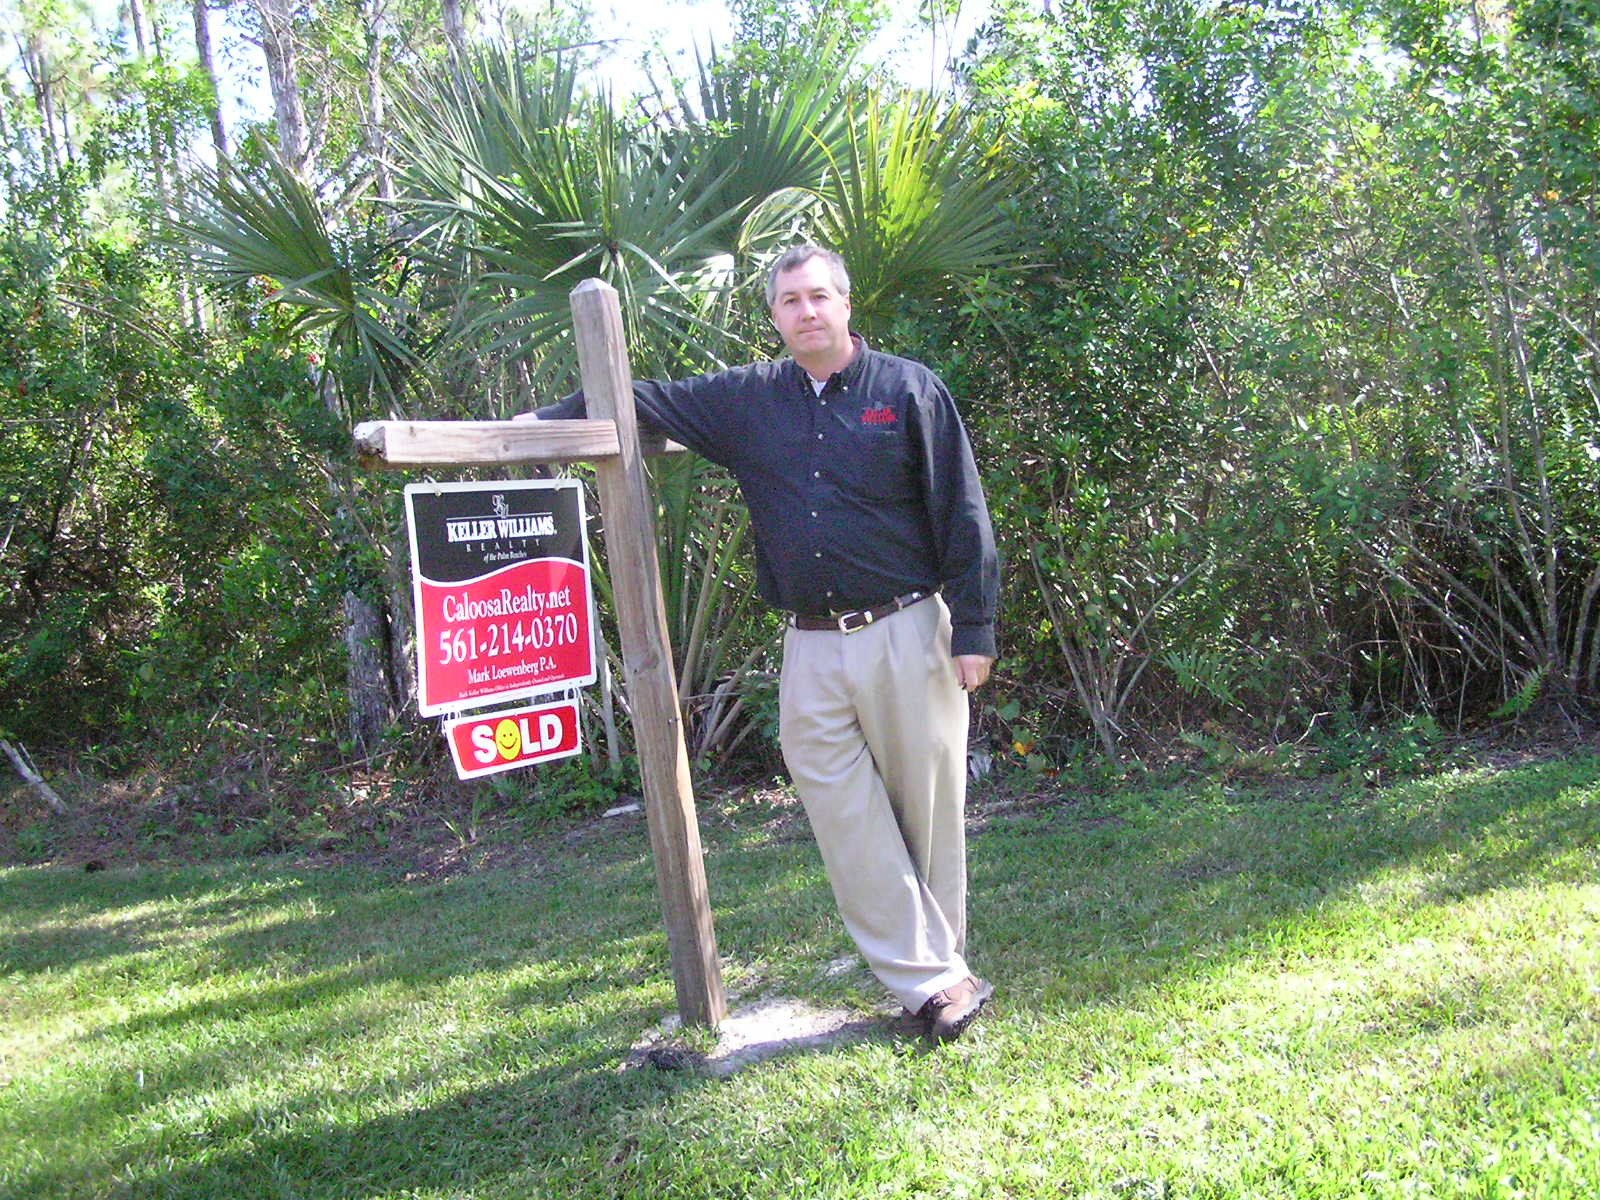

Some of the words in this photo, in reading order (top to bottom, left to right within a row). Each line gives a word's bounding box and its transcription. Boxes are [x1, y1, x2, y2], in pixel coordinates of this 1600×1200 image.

[446, 519, 497, 543] KELLER
[442, 584, 571, 623] CaloosaRealty.net
[439, 612, 578, 665] 561-214-0370
[467, 665, 491, 685] Mark
[492, 658, 540, 680] Loewenberg
[539, 655, 557, 671] P.A.
[471, 713, 563, 763] SOLD
